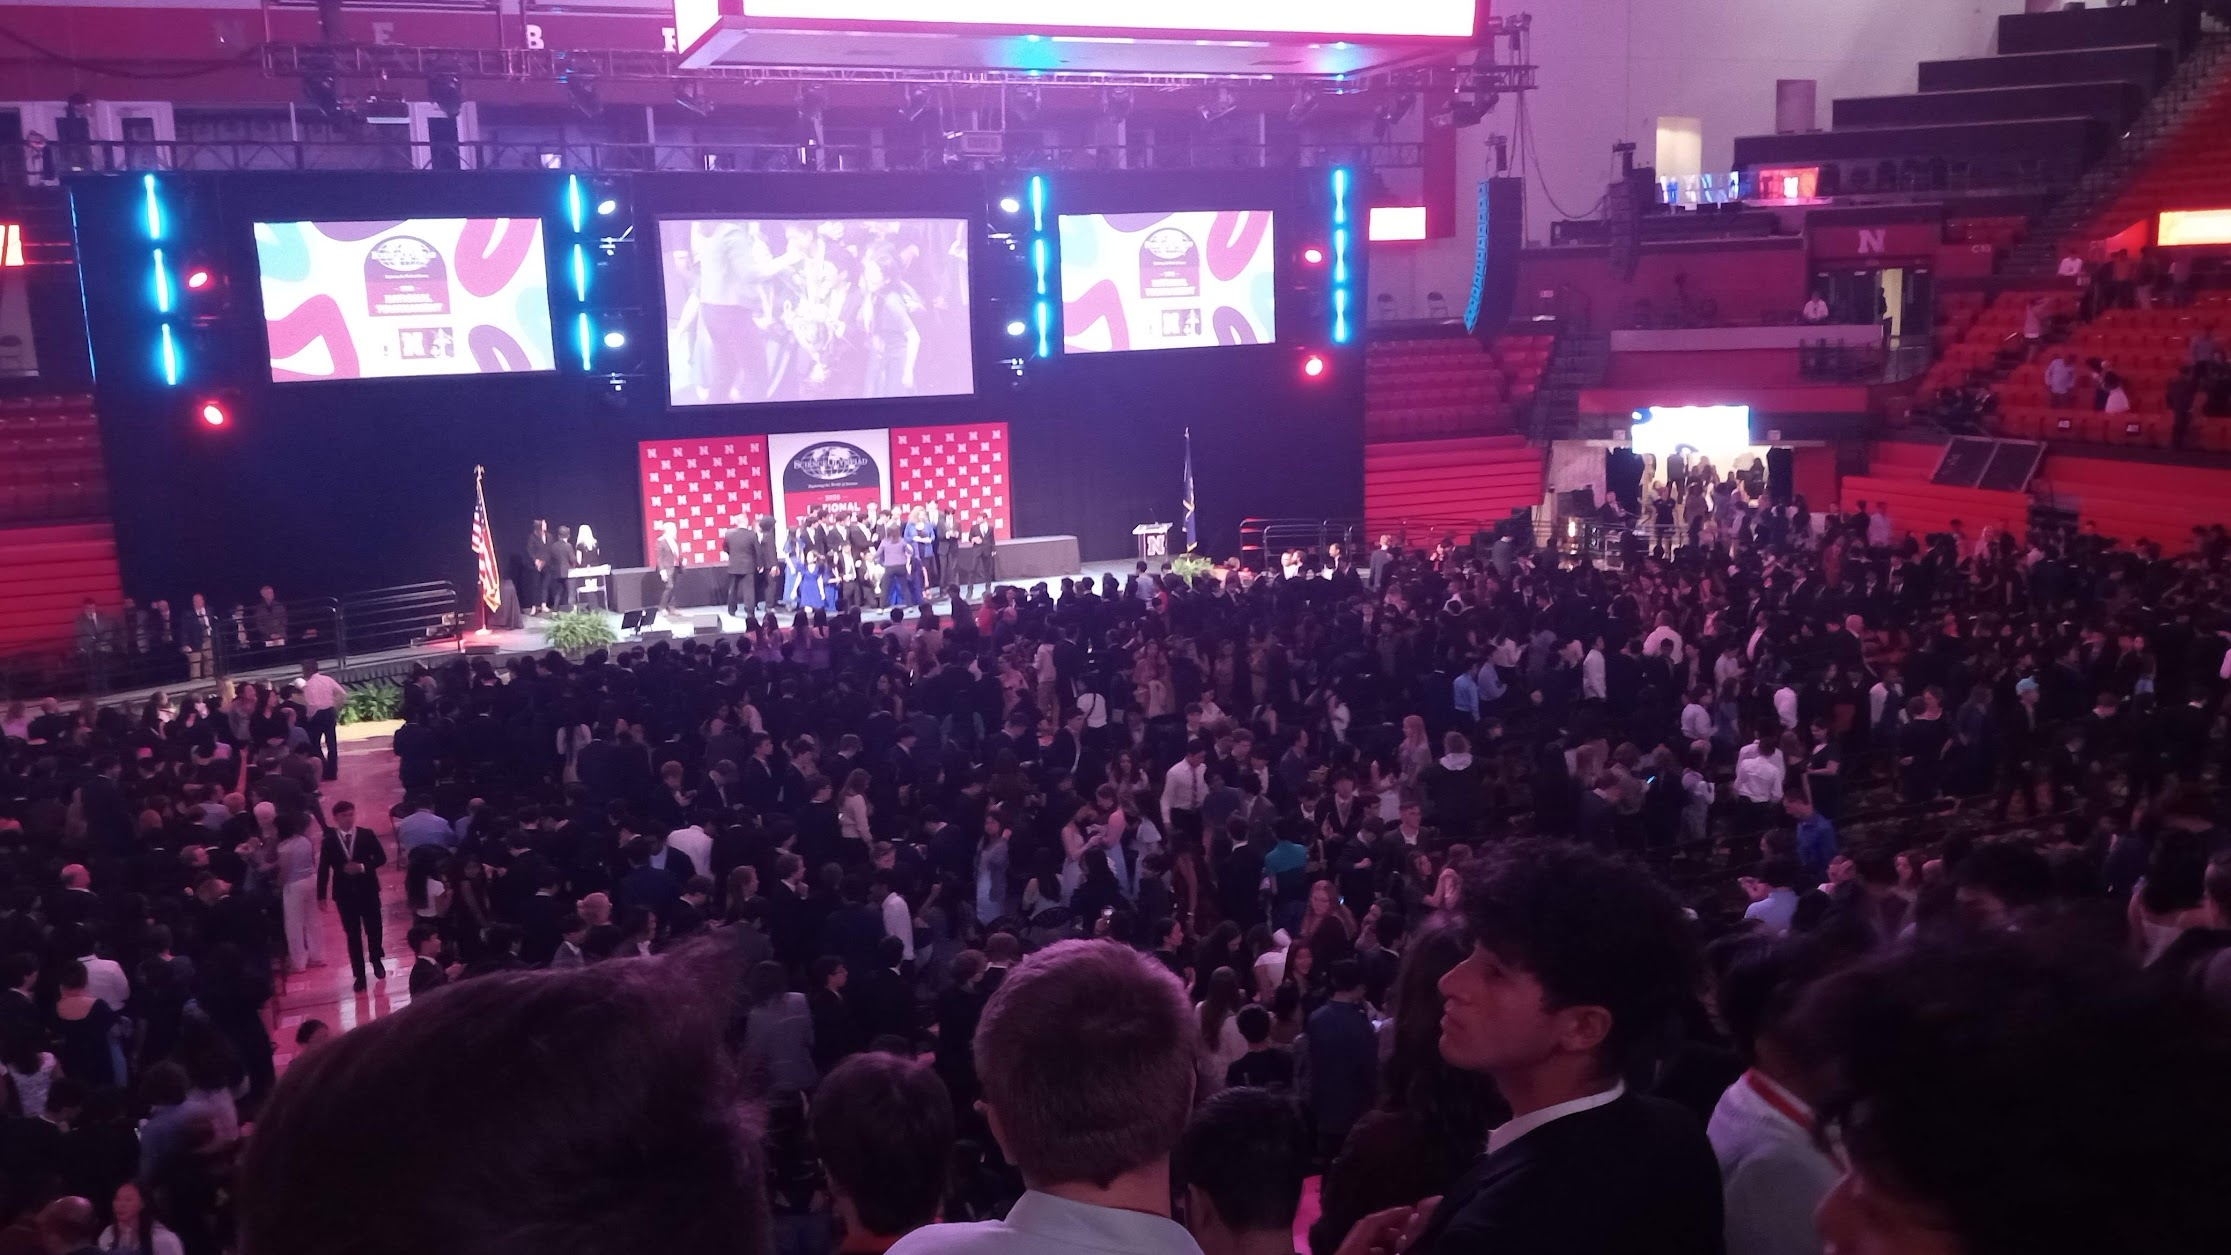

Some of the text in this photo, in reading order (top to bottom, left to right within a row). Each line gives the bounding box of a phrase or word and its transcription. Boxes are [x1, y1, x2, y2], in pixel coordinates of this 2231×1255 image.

[526, 24, 545, 50] B
[1858, 230, 1886, 254] N
[647, 443, 759, 458] N N N N N
[661, 456, 748, 470] N N N N
[650, 467, 760, 482] N N N N N
[663, 479, 749, 494] N N N N
[651, 490, 762, 506] N N N N N
[807, 502, 861, 515] TIONAL
[1147, 534, 1166, 556] N
